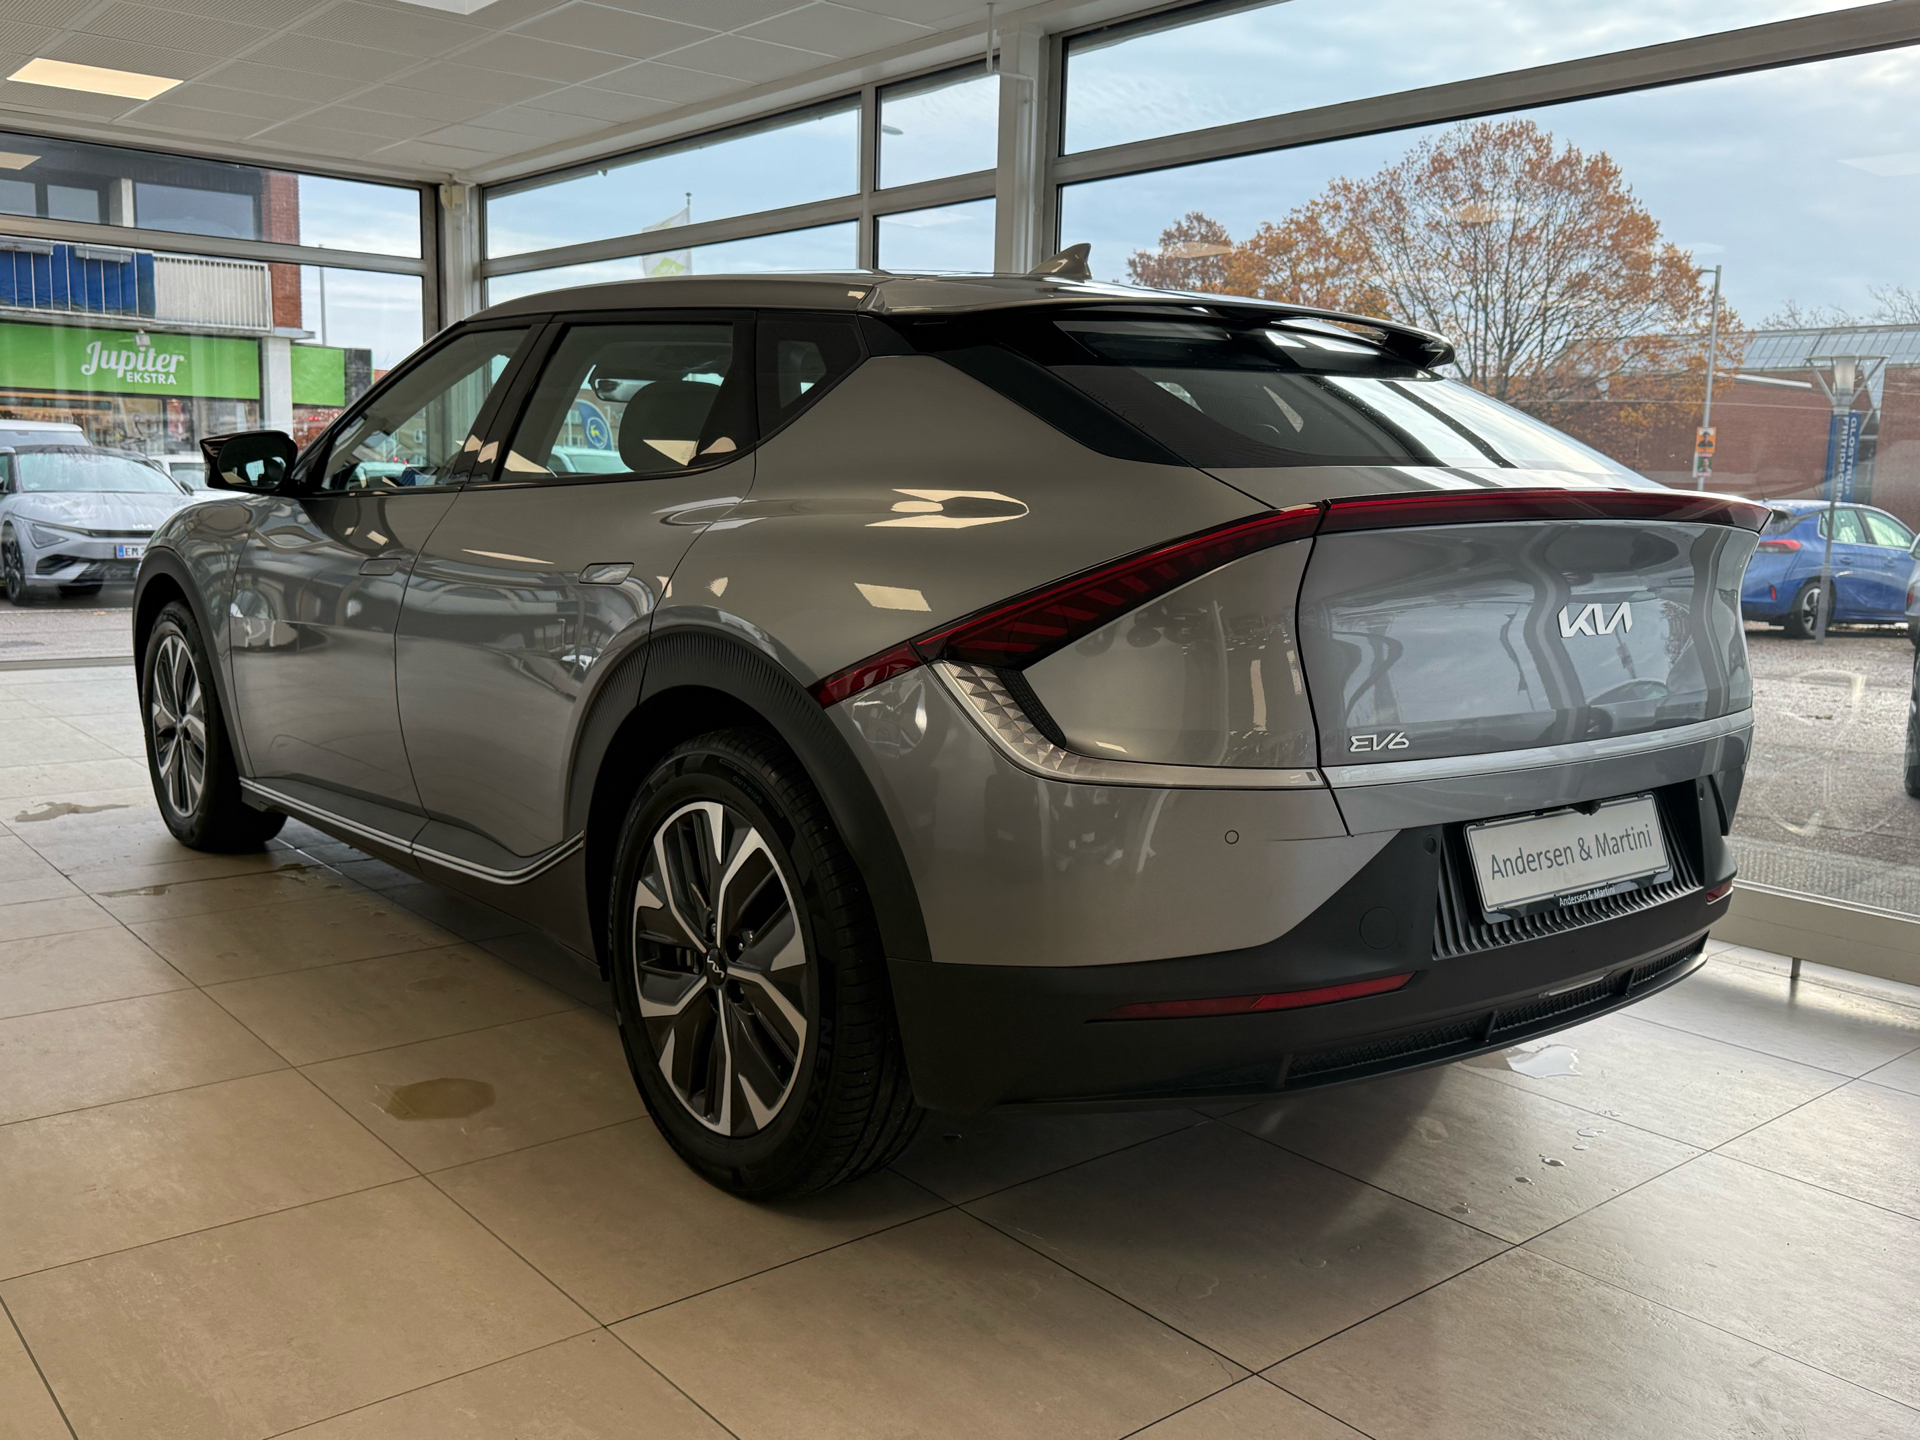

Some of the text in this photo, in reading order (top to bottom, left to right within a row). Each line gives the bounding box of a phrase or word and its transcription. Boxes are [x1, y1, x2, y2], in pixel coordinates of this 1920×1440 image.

[81, 341, 185, 379] Jupiter
[126, 371, 178, 386] EKSTRA
[1836, 417, 1849, 502] FRITIDSCEN
[1845, 417, 1857, 495] GLOSTRUP
[1558, 601, 1632, 639] KIA
[1349, 731, 1410, 753] EV6
[1491, 823, 1653, 880] Andersen & Martini
[1559, 885, 1616, 907] Andersen & Martini
